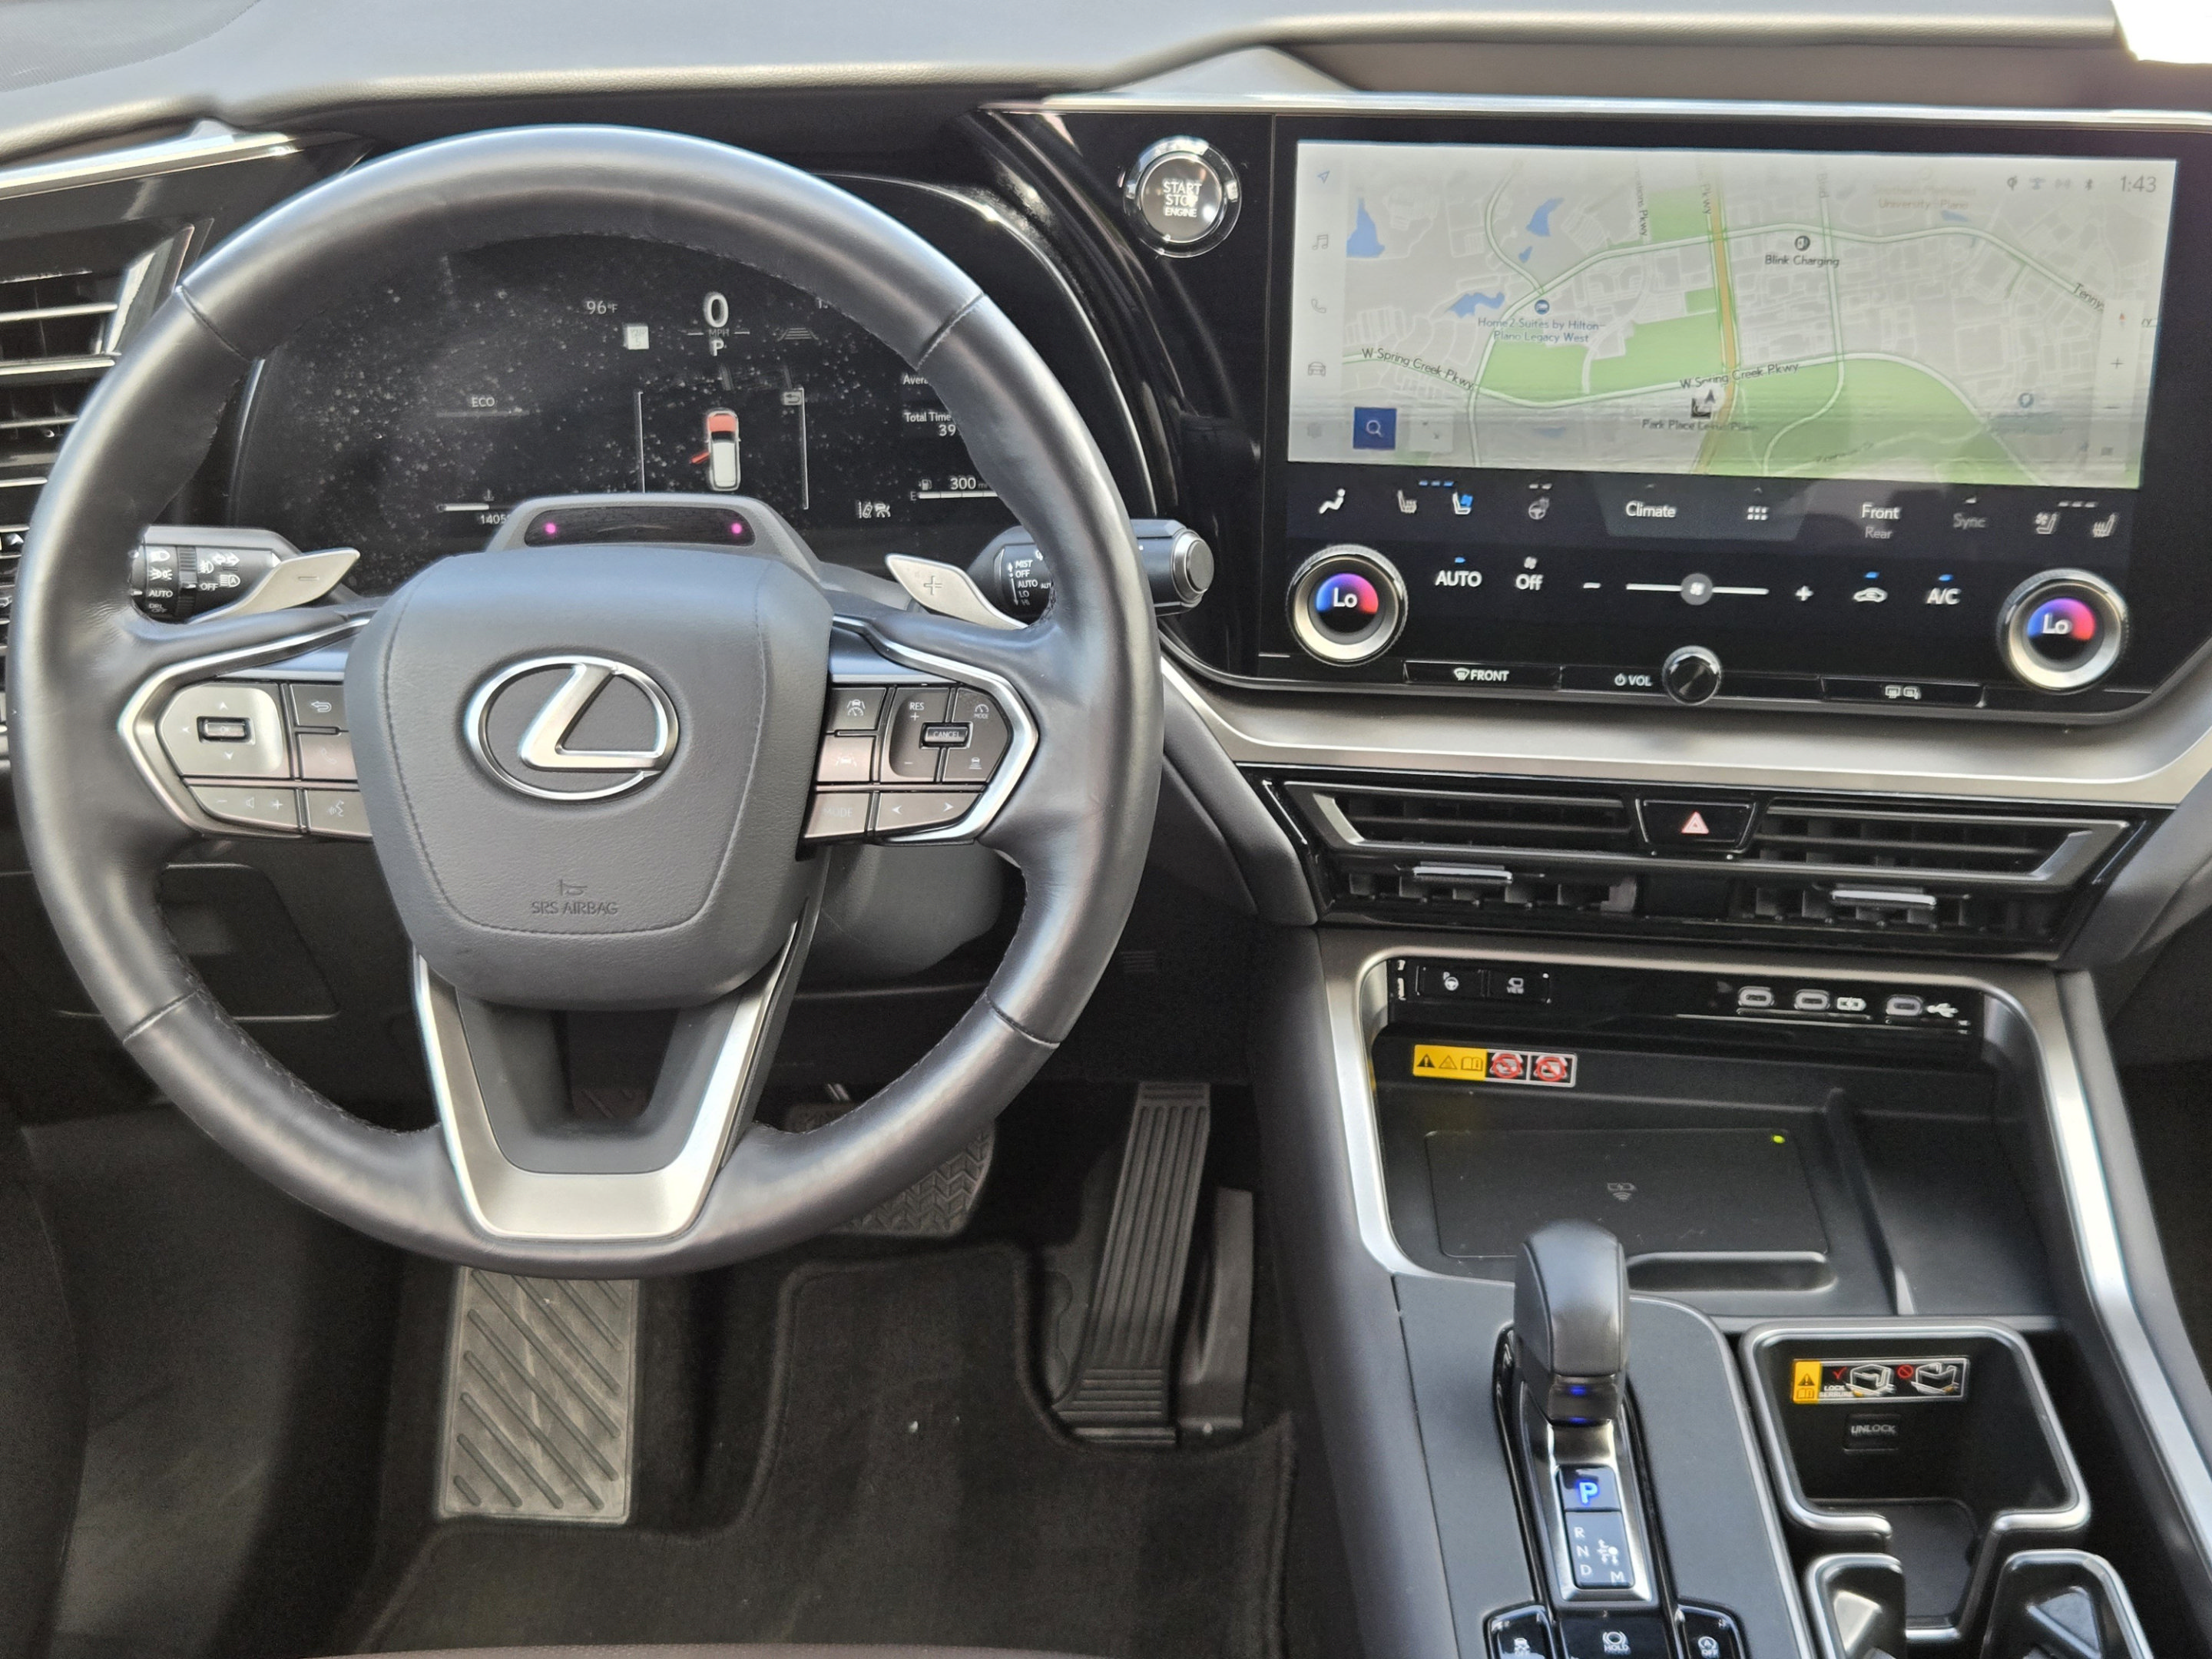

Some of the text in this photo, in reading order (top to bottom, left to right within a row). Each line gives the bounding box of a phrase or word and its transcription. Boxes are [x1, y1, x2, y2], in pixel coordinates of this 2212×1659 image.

[1163, 180, 1202, 195] START
[2120, 175, 2157, 193] 1:43
[1165, 194, 1198, 207] STOP
[1164, 207, 1197, 217] ENGINE
[1639, 210, 1648, 236] Pkwy
[1765, 255, 1840, 268] Blink Charging
[707, 293, 729, 328] 0
[1519, 318, 1549, 329] Suites
[1552, 320, 1565, 330] by
[708, 329, 730, 337] MPH
[1493, 330, 1589, 343] Plano Legacy West
[710, 339, 725, 357] P
[1362, 348, 1474, 390] W Spring Creek Pkwy
[1680, 379, 1692, 389] W
[1732, 367, 1764, 381] Creek
[1767, 363, 1800, 376] Pkwy
[472, 396, 495, 408] ECO
[904, 412, 952, 422] Total Time
[939, 424, 956, 437] 39
[1641, 419, 1664, 429] Park
[1668, 419, 1695, 430] Place
[950, 478, 976, 490] 300
[910, 492, 917, 501] E
[1625, 502, 1677, 518] Climate
[1861, 504, 1901, 522] Front
[1952, 513, 1986, 530] Sync
[1865, 526, 1893, 540] Rear
[1015, 560, 1033, 568] MIST
[1018, 579, 1038, 588] AUTO
[1435, 571, 1482, 588] AUTO
[1515, 573, 1543, 591] Off
[149, 589, 174, 598] AUTO
[1333, 587, 1358, 609] Lo
[1926, 588, 1962, 605] A/C
[2042, 614, 2071, 635] Lo
[1470, 670, 1509, 682] FRONT
[1628, 674, 1652, 687] VOL
[909, 702, 925, 710] RES
[823, 807, 853, 817] MODE
[531, 902, 618, 916] SRS AIRBAG
[1851, 1424, 1896, 1435] UNLOCK
[1579, 1482, 1599, 1504] P
[1575, 1527, 1585, 1538] R
[1577, 1546, 1589, 1557] N
[1580, 1565, 1592, 1575] D
[1610, 1571, 1625, 1583] M
[1604, 1644, 1629, 1653] HOLD
